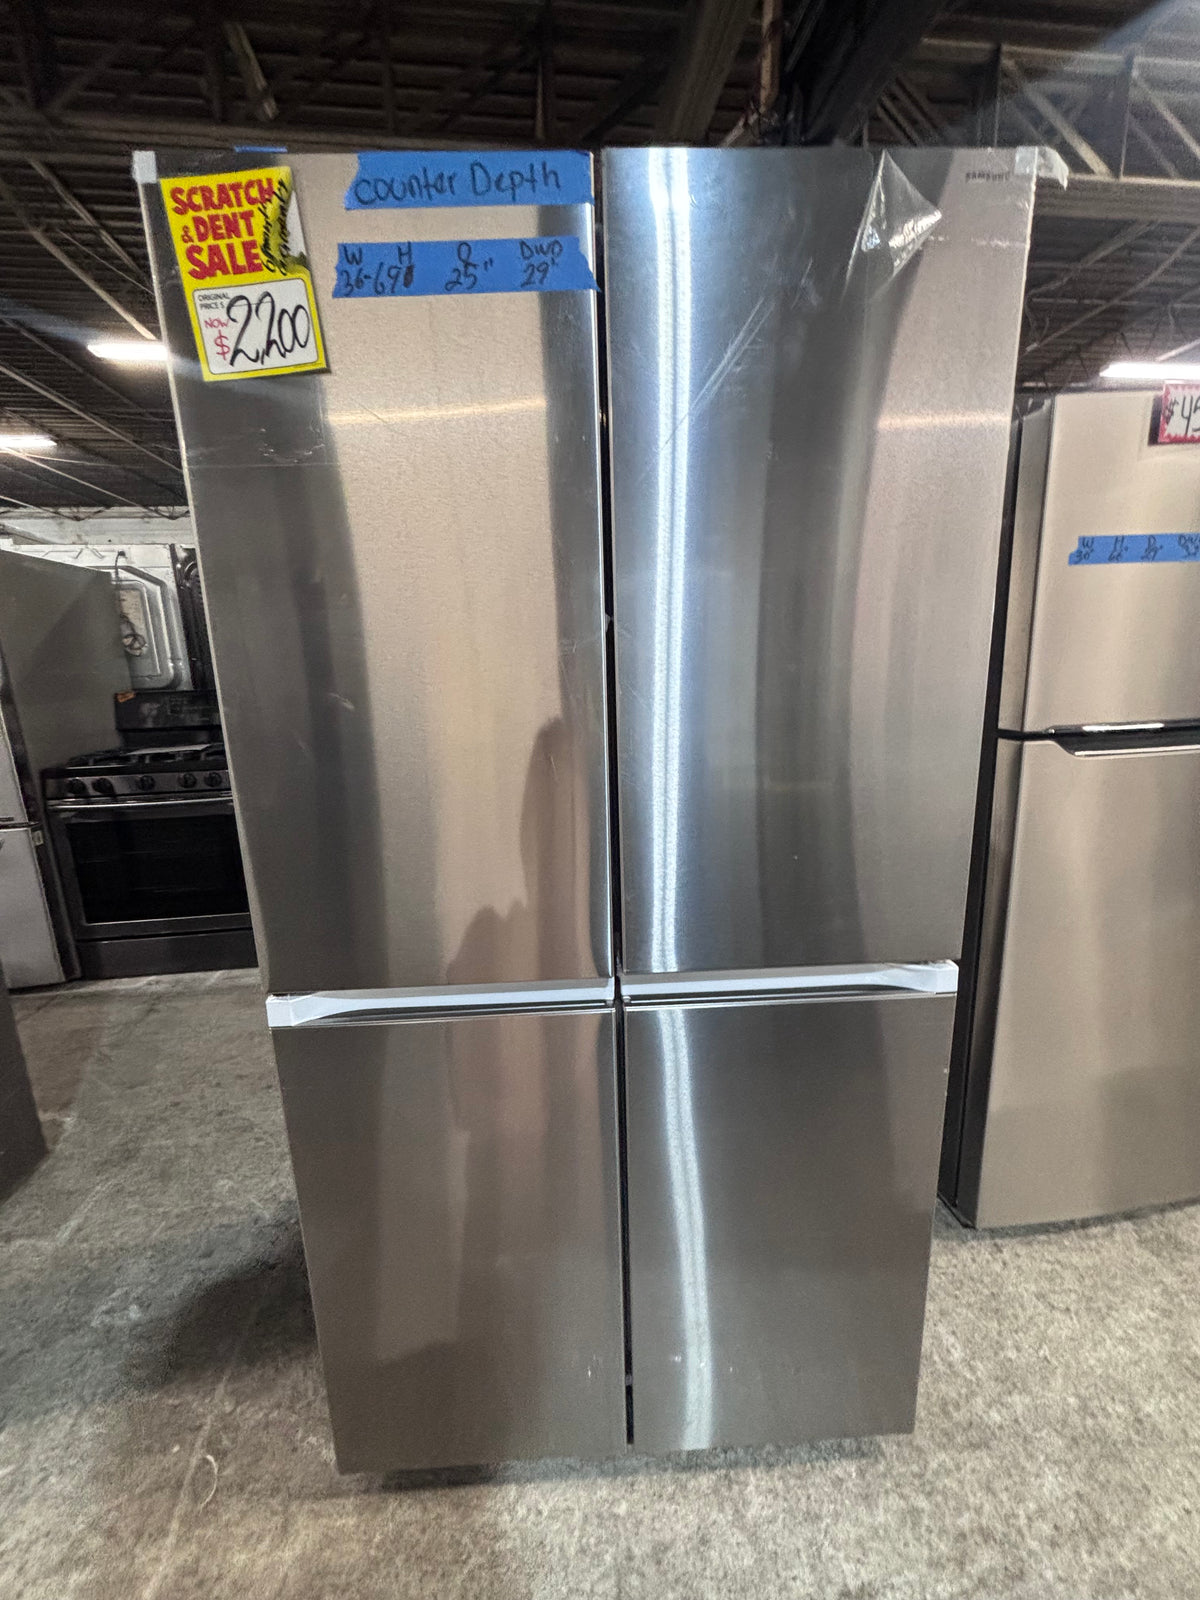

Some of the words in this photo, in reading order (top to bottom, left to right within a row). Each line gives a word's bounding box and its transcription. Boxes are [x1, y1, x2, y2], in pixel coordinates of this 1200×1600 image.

[469, 160, 562, 201] Depth
[170, 177, 275, 215] SCRATCH
[181, 225, 194, 243] &
[192, 210, 255, 243] DENT
[184, 239, 264, 280] SALE
[342, 244, 363, 265] W
[396, 241, 413, 265] H
[197, 292, 230, 301] ORIGINAL
[199, 302, 220, 310] PRICE
[204, 317, 229, 328] NOW
